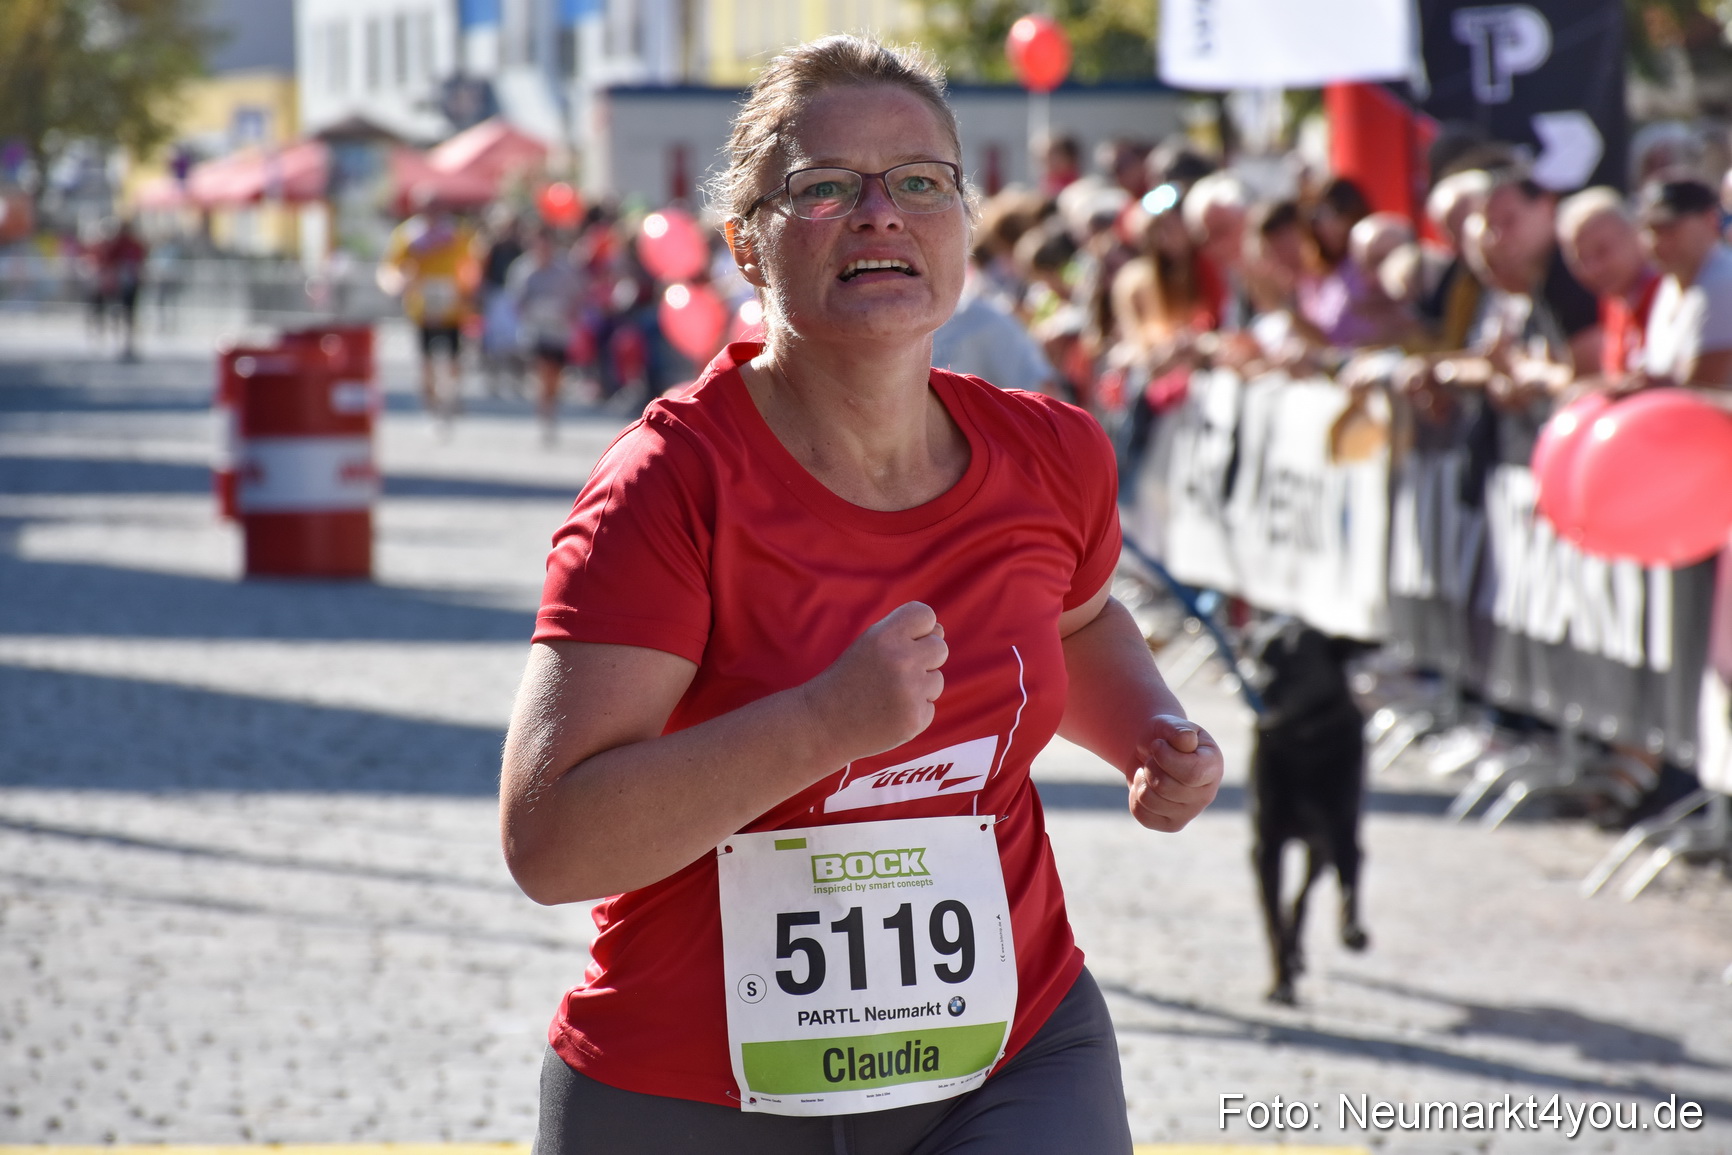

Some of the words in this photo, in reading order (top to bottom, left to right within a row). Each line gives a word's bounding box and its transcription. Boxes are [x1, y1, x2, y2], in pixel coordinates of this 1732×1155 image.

[871, 762, 954, 789] DEHN
[811, 848, 930, 883] BOCK
[813, 883, 853, 895] inspired
[855, 882, 866, 892] by
[869, 880, 895, 890] smart
[897, 878, 934, 888] concepts
[775, 899, 976, 996] 5119
[746, 981, 757, 997] S
[797, 1008, 860, 1026] PARTL
[864, 1002, 942, 1022] Neumarkt
[822, 1039, 940, 1083] Claudia
